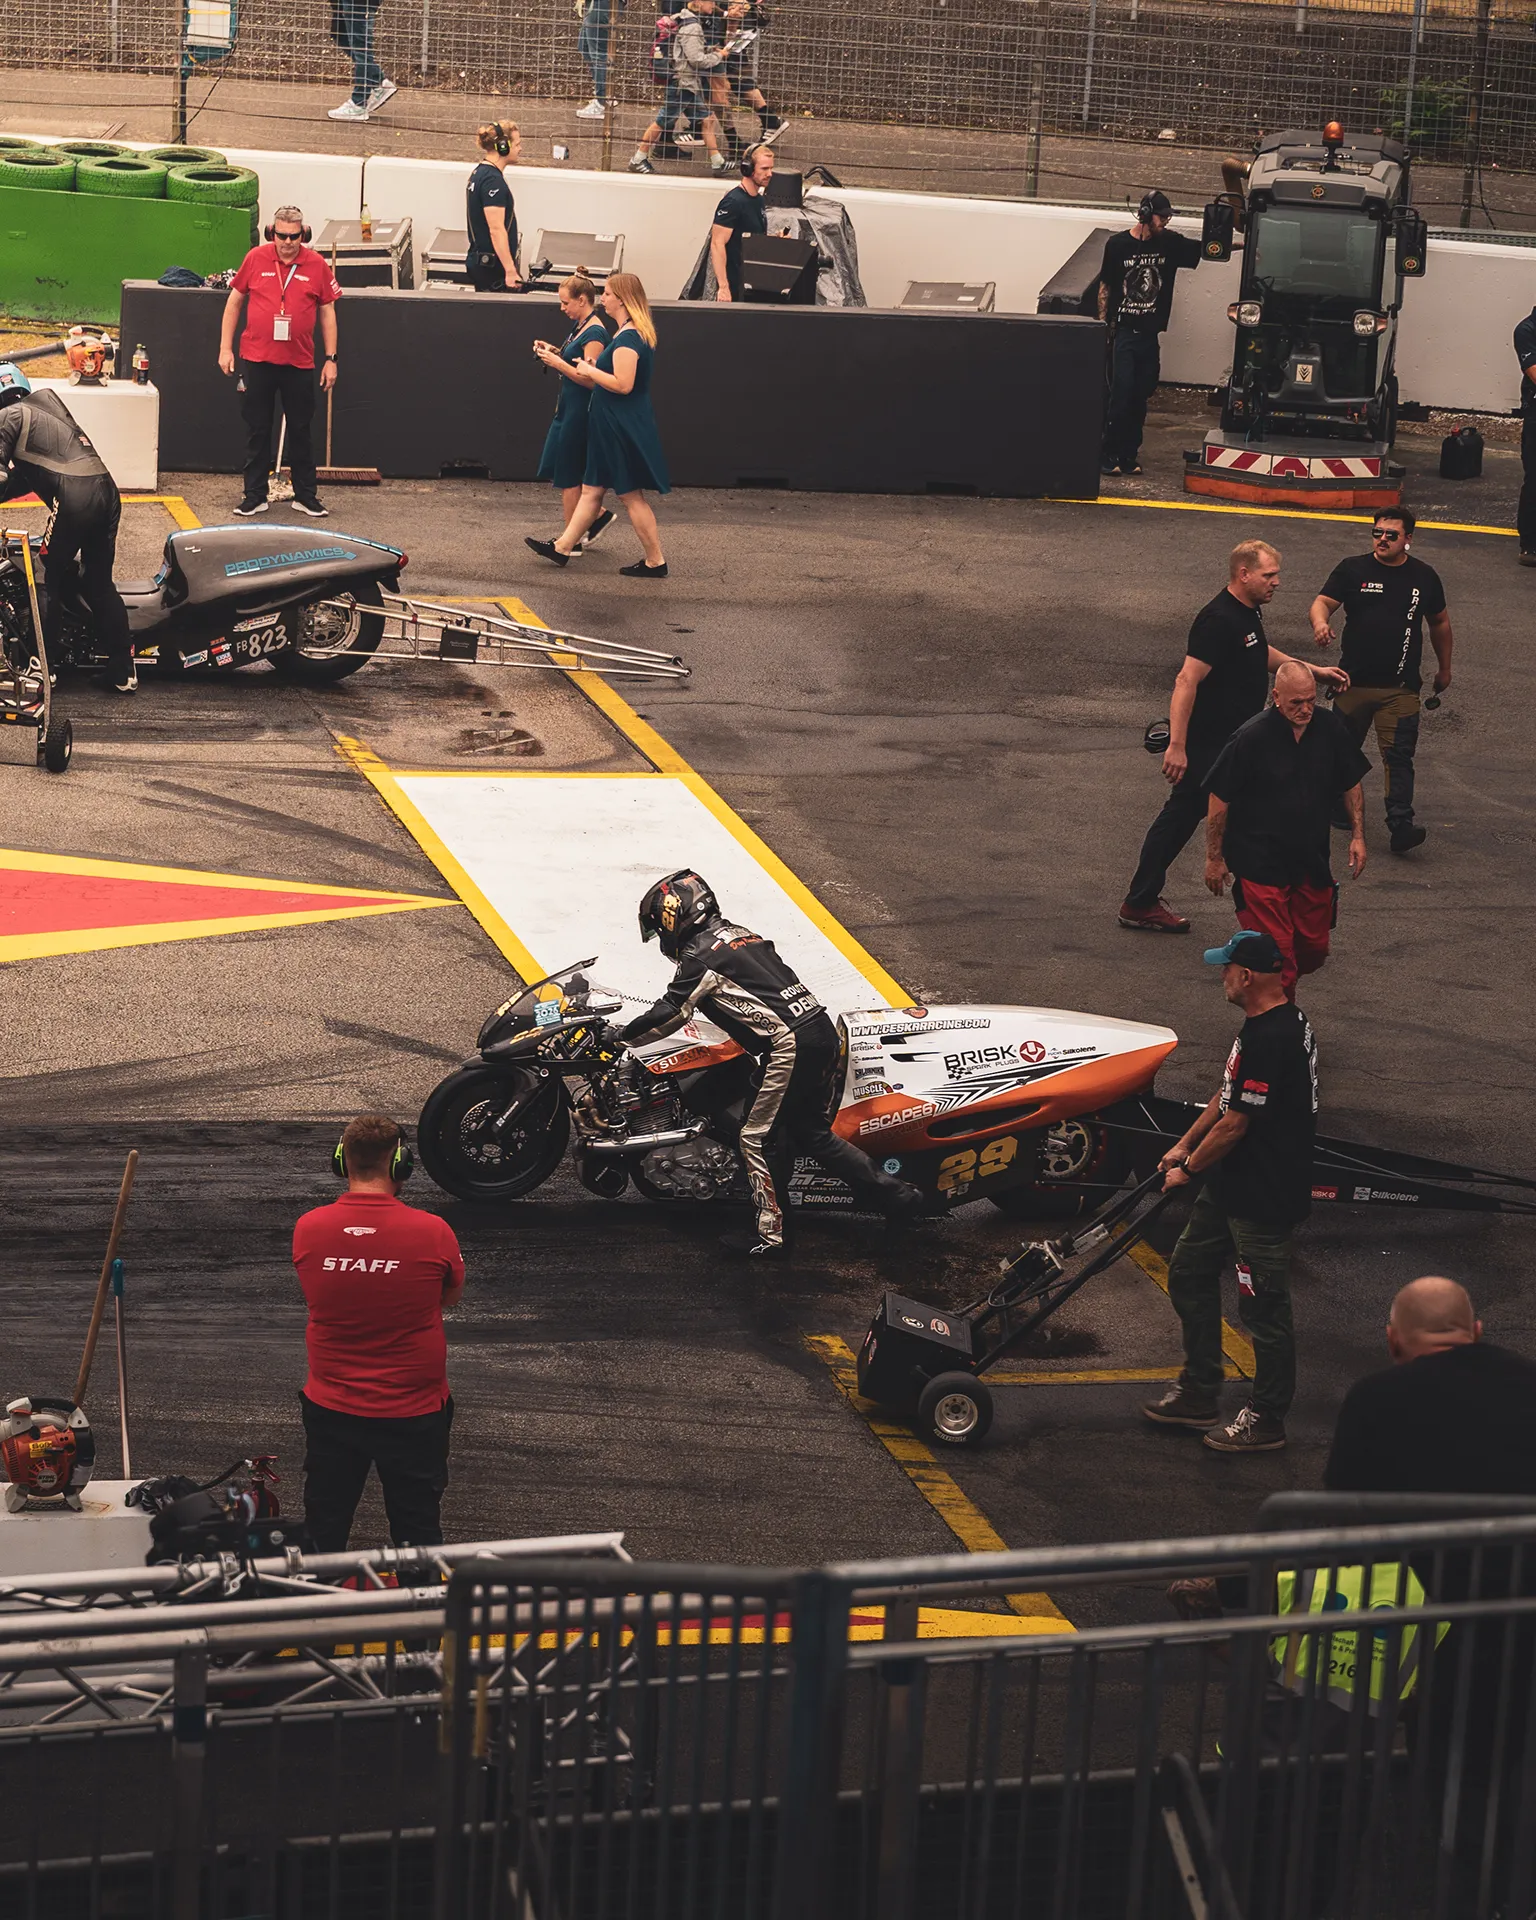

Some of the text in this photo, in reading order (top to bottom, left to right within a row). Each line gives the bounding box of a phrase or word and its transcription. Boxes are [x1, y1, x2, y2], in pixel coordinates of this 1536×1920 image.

[224, 547, 345, 575] PRODYNAMICS
[1408, 588, 1420, 620] DRAG
[236, 640, 248, 654] FB
[249, 625, 288, 657] 823
[851, 1019, 991, 1037] WWW.CESKARACING.COM
[943, 1044, 1017, 1072] BRISK
[1063, 1046, 1097, 1056] Silkolene
[995, 1059, 1020, 1067] PLUGS
[853, 1083, 884, 1098] MUSCLE
[860, 1103, 933, 1134] ESCAPE6
[937, 1135, 1018, 1191] 29
[804, 1194, 854, 1204] Silkolene
[1371, 1191, 1419, 1202] Silkolene
[322, 1257, 401, 1274] STAFF
